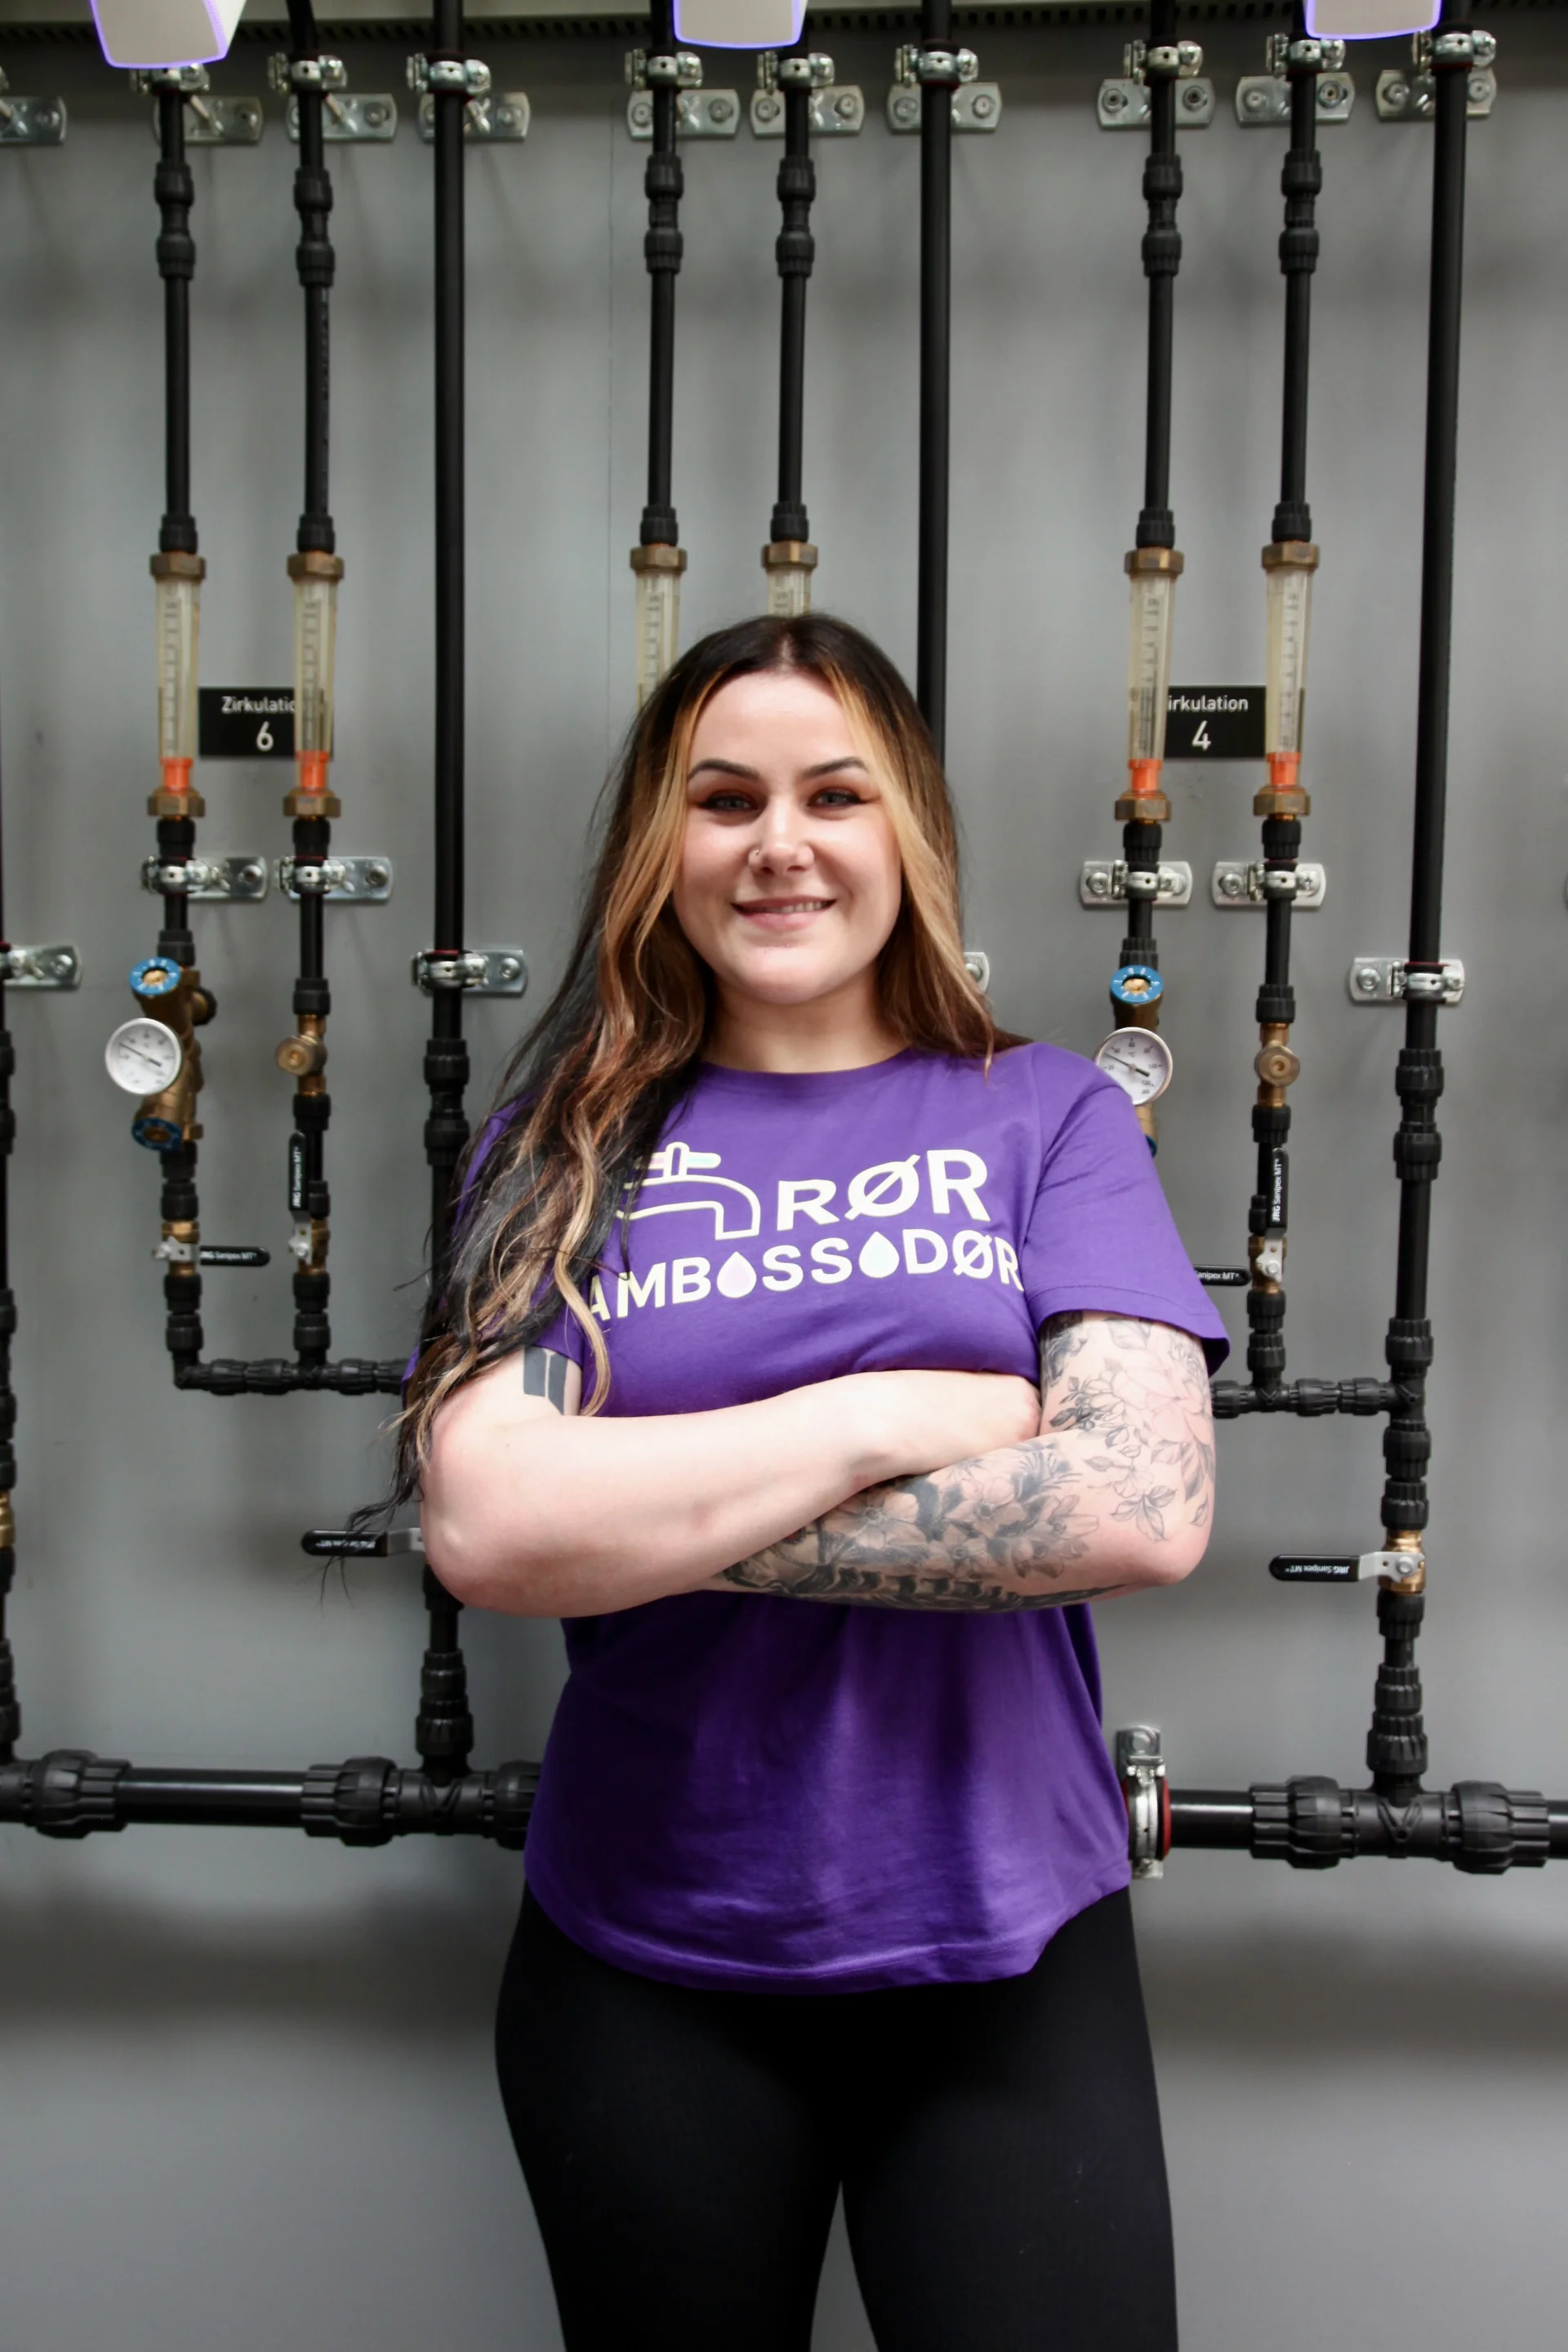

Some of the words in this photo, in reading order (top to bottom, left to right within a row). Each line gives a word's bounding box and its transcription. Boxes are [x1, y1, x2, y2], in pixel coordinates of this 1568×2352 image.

[221, 696, 296, 714] Zirkulatio
[1168, 694, 1249, 712] irkulation
[256, 720, 274, 751] 6
[1192, 720, 1211, 751] 4
[777, 1149, 991, 1232] RØR
[1273, 1176, 1283, 1205] Sanipex
[1272, 1205, 1281, 1222] JRG
[1303, 1564, 1332, 1574] Sanipex
